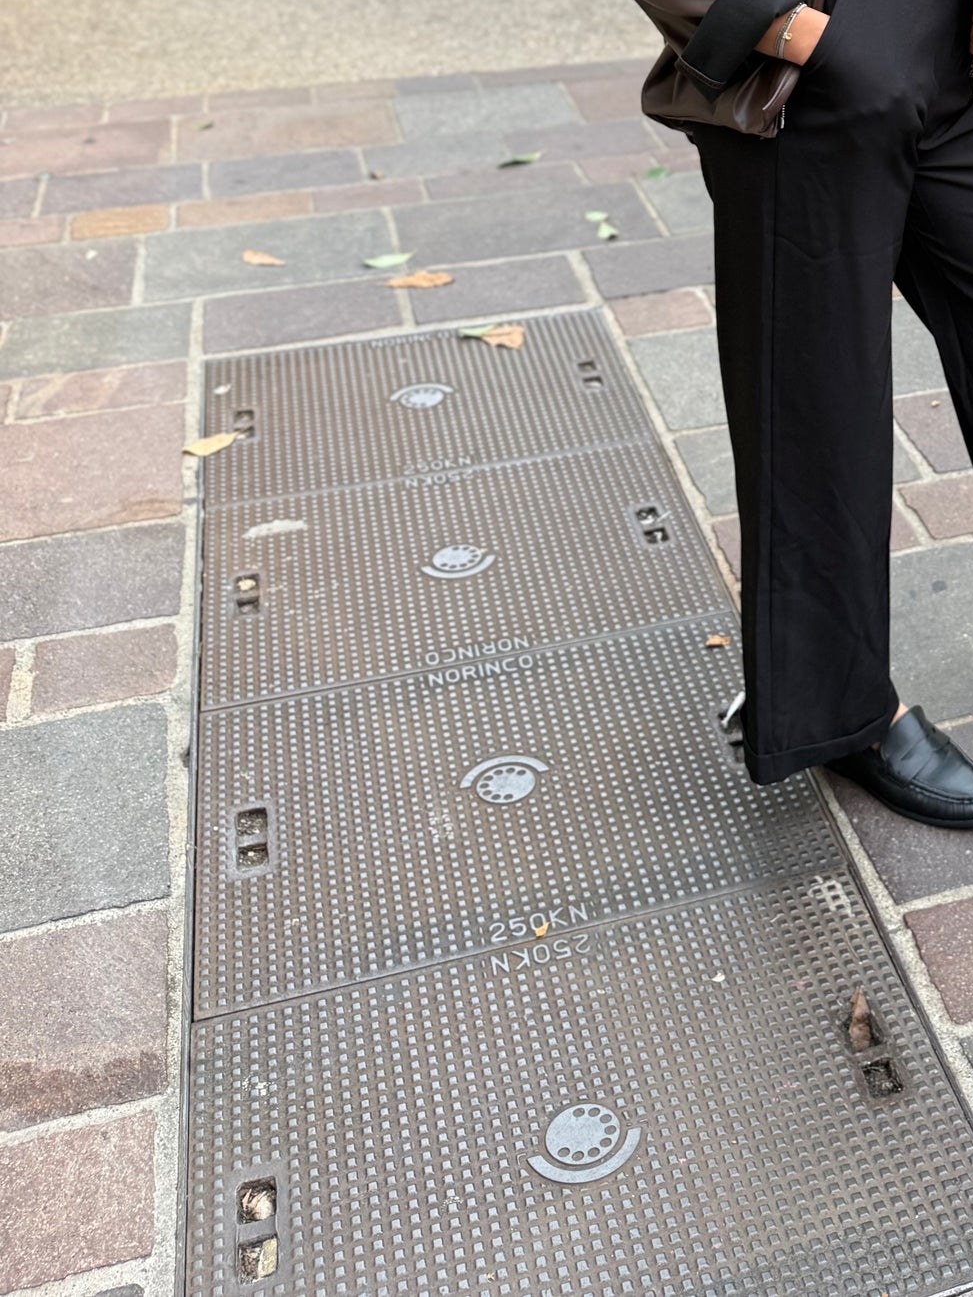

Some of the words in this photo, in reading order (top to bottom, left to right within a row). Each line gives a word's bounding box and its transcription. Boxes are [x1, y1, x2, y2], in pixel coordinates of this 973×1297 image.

[425, 635, 529, 665] NORINCO
[428, 655, 533, 687] NORINCO
[489, 902, 588, 942] 250KN
[490, 934, 591, 976] 250KN
